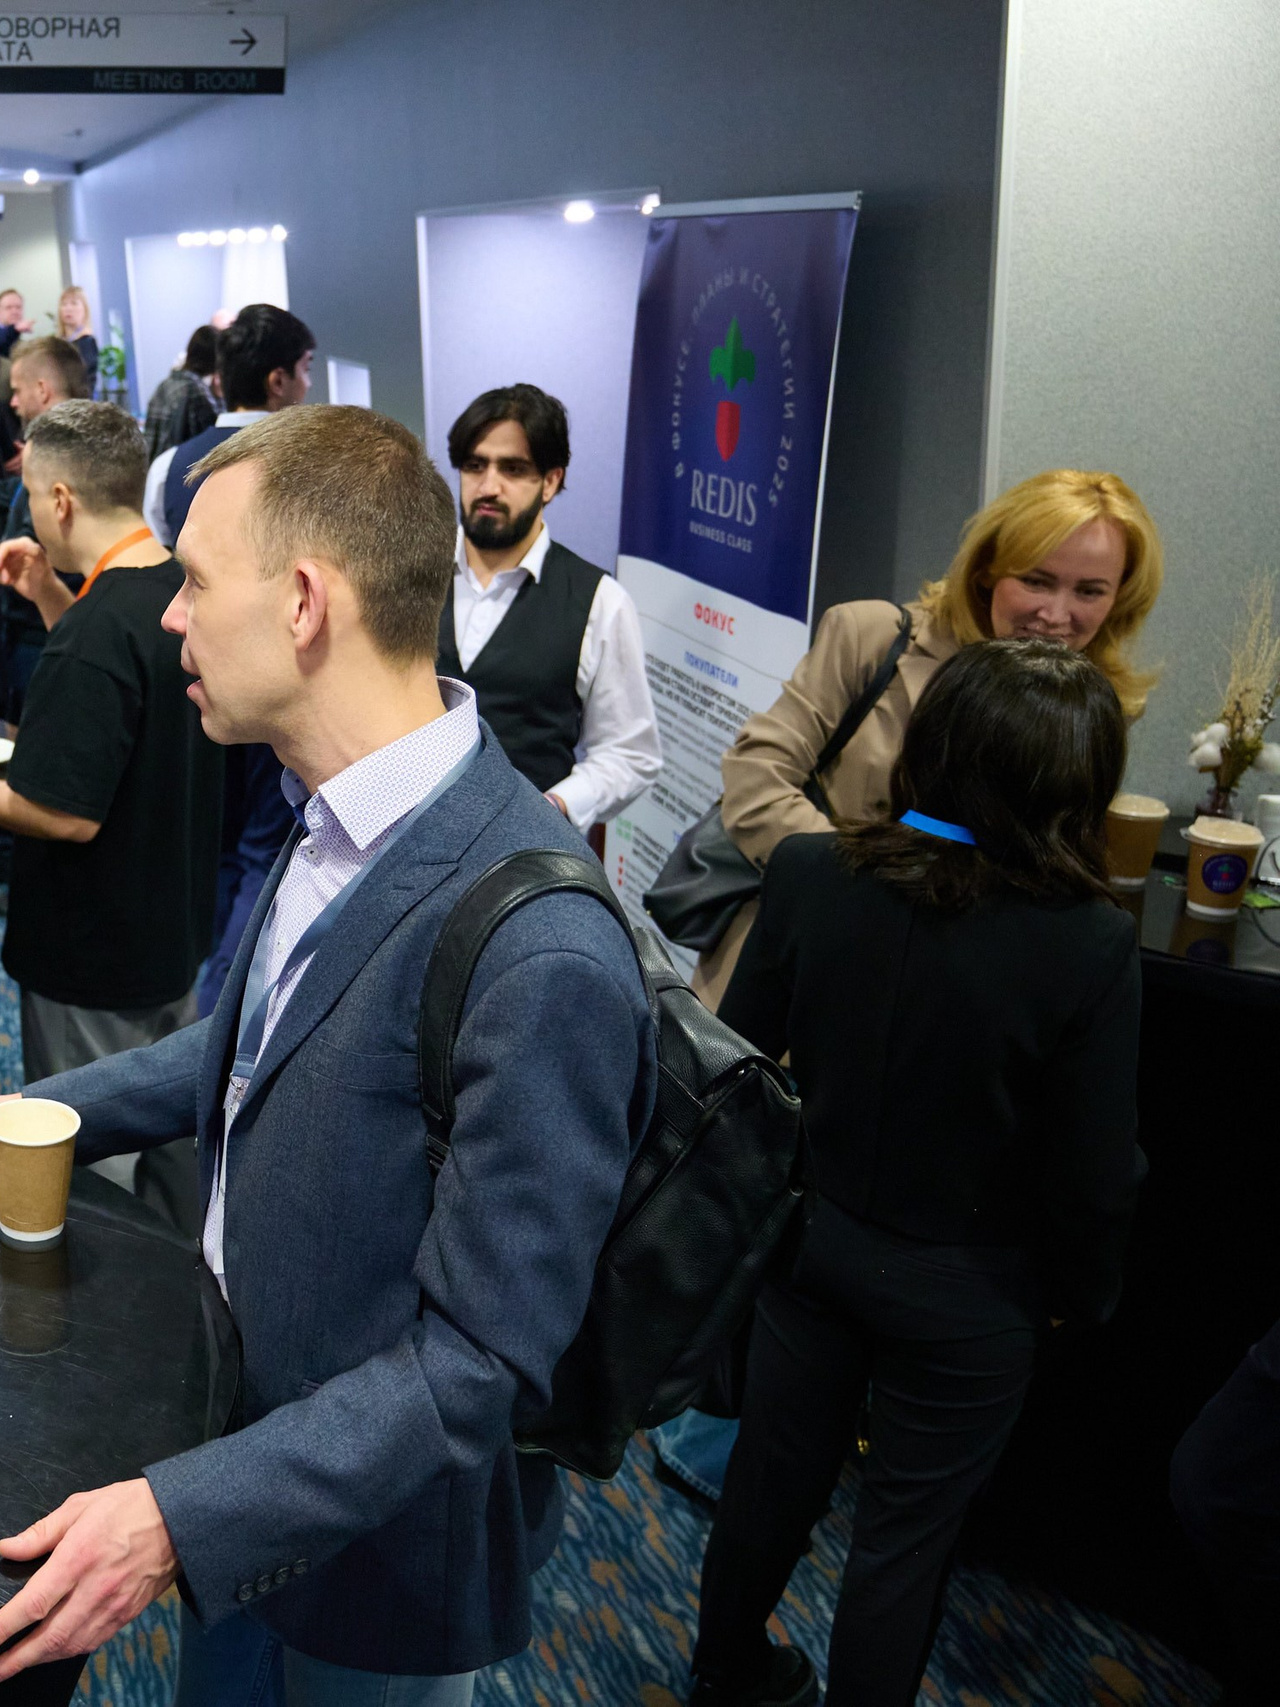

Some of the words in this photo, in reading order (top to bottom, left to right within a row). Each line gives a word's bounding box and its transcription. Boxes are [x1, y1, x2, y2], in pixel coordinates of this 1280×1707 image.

[93, 72, 184, 91] MEETING
[194, 72, 257, 91] ROOM
[690, 468, 758, 527] REDIS
[693, 602, 735, 636] ФОКУС
[684, 651, 739, 688] ПОКУПАТЕЛИ
